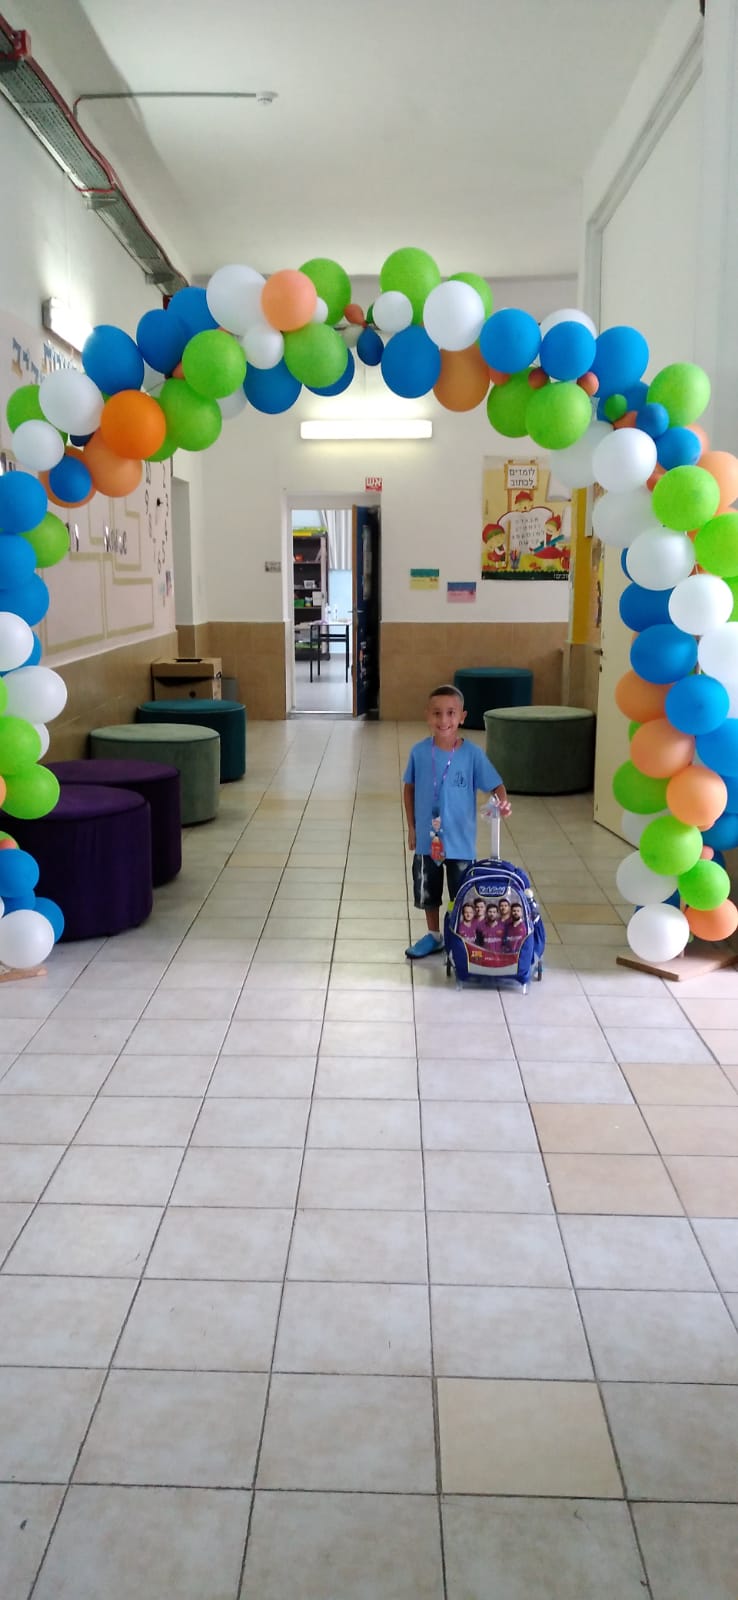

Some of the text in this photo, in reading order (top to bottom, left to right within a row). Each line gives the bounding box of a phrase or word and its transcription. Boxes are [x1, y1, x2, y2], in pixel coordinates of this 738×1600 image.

[509, 466, 535, 476] לומדים
[366, 477, 382, 487] אש
[510, 477, 533, 487] לכתוב
